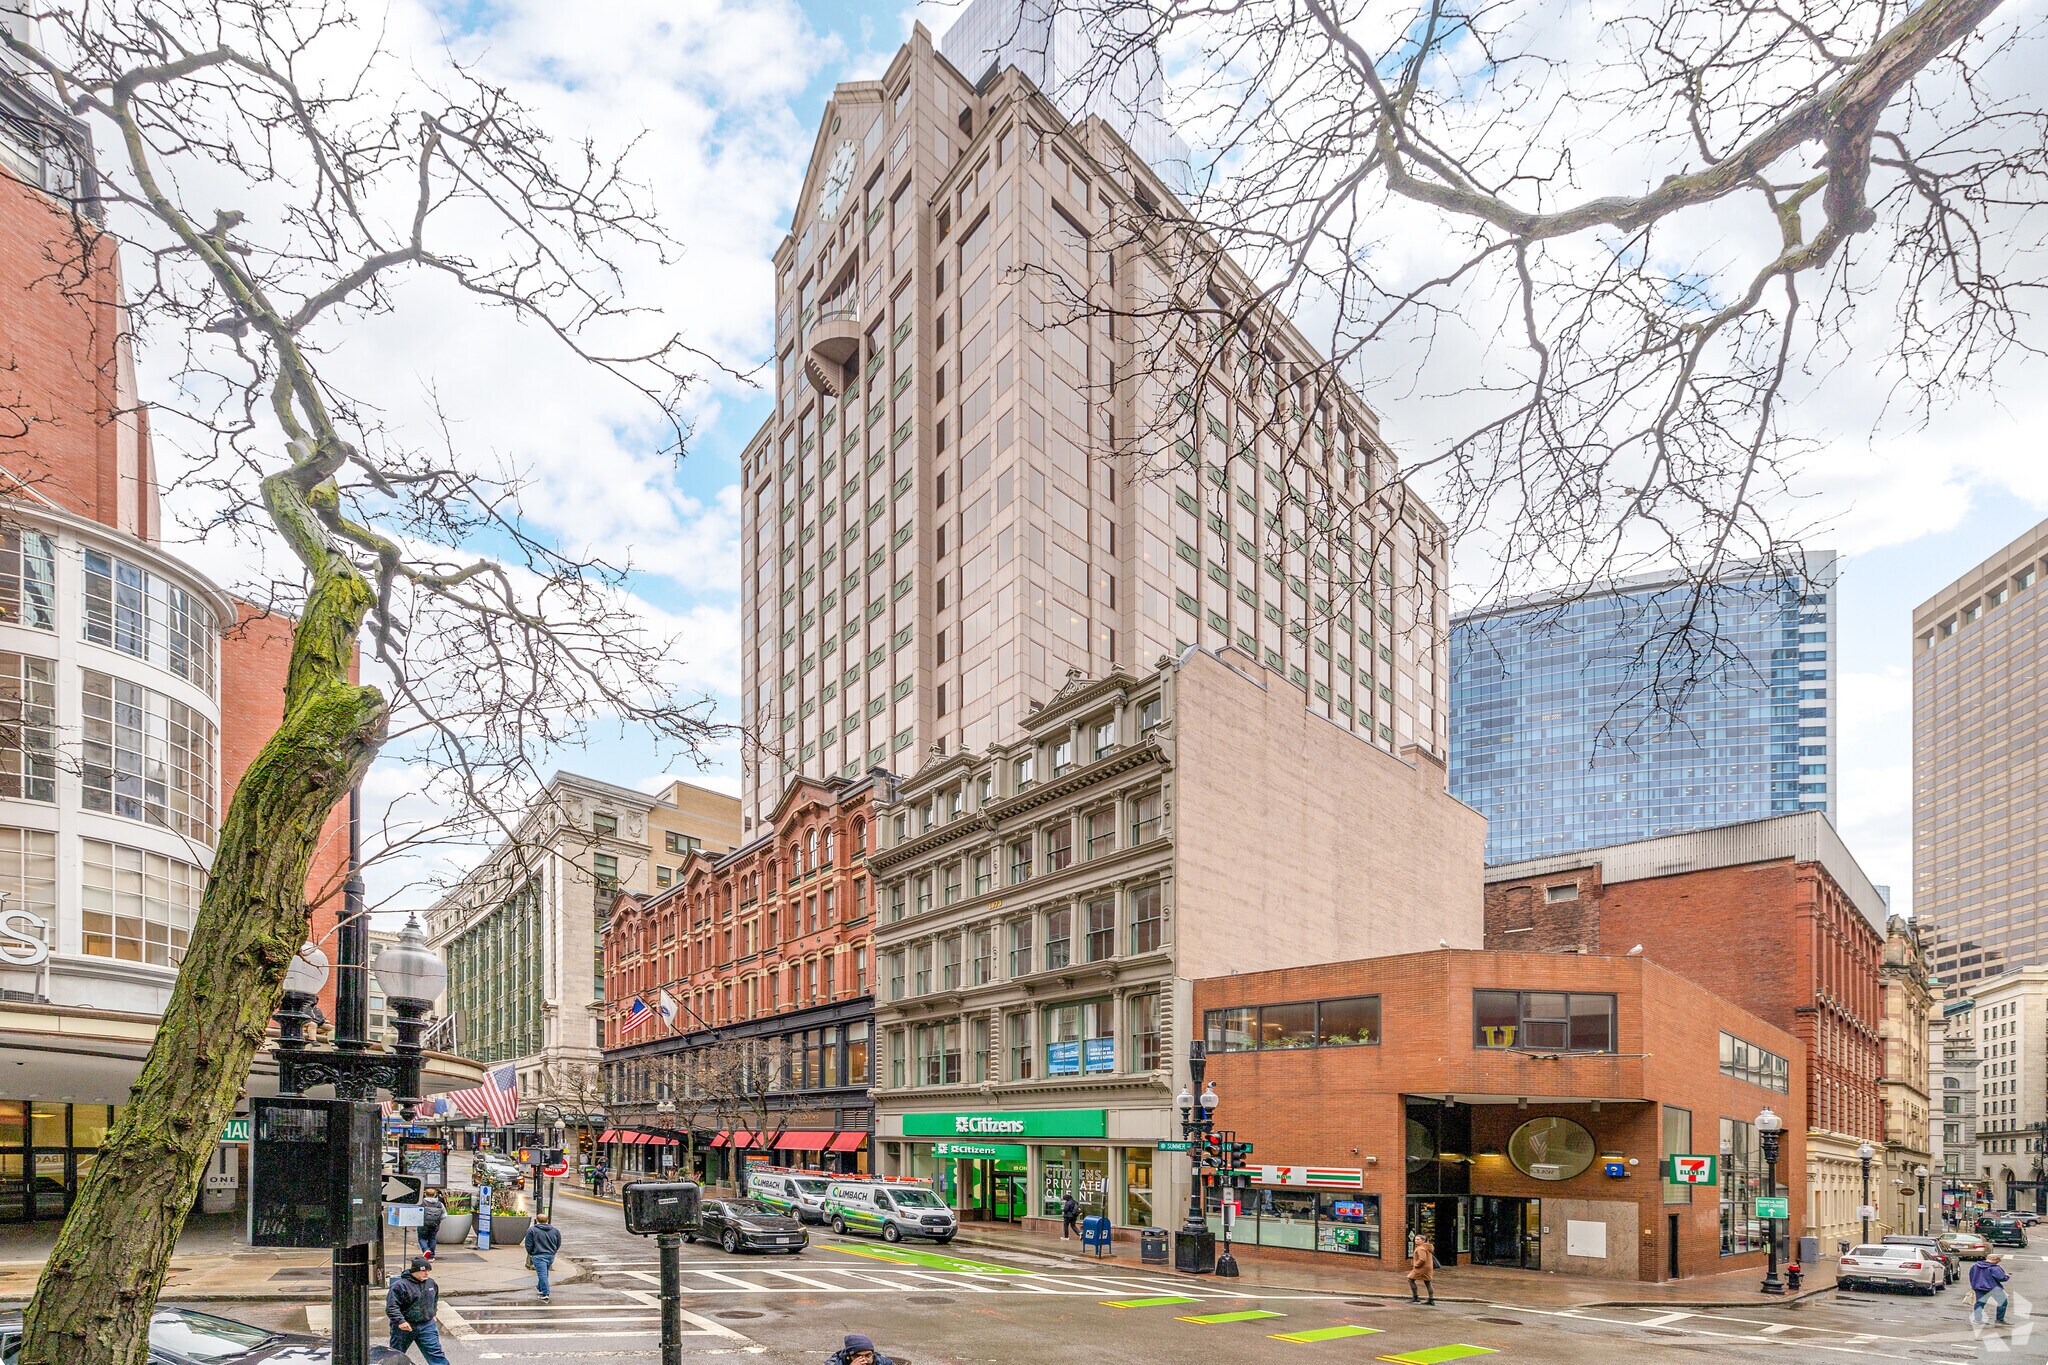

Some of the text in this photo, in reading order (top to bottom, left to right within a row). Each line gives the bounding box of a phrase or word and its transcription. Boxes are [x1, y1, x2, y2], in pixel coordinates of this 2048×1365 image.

[969, 1117, 1024, 1133] Citizens
[959, 1145, 996, 1155] Citizens
[1046, 1167, 1102, 1180] CITIZENS
[1277, 1167, 1291, 1183] 7
[1681, 1160, 1705, 1182] 7
[757, 1179, 780, 1189] LIMBACH
[1046, 1178, 1102, 1191] PRIVATE
[839, 1190, 868, 1201] LIMBACH
